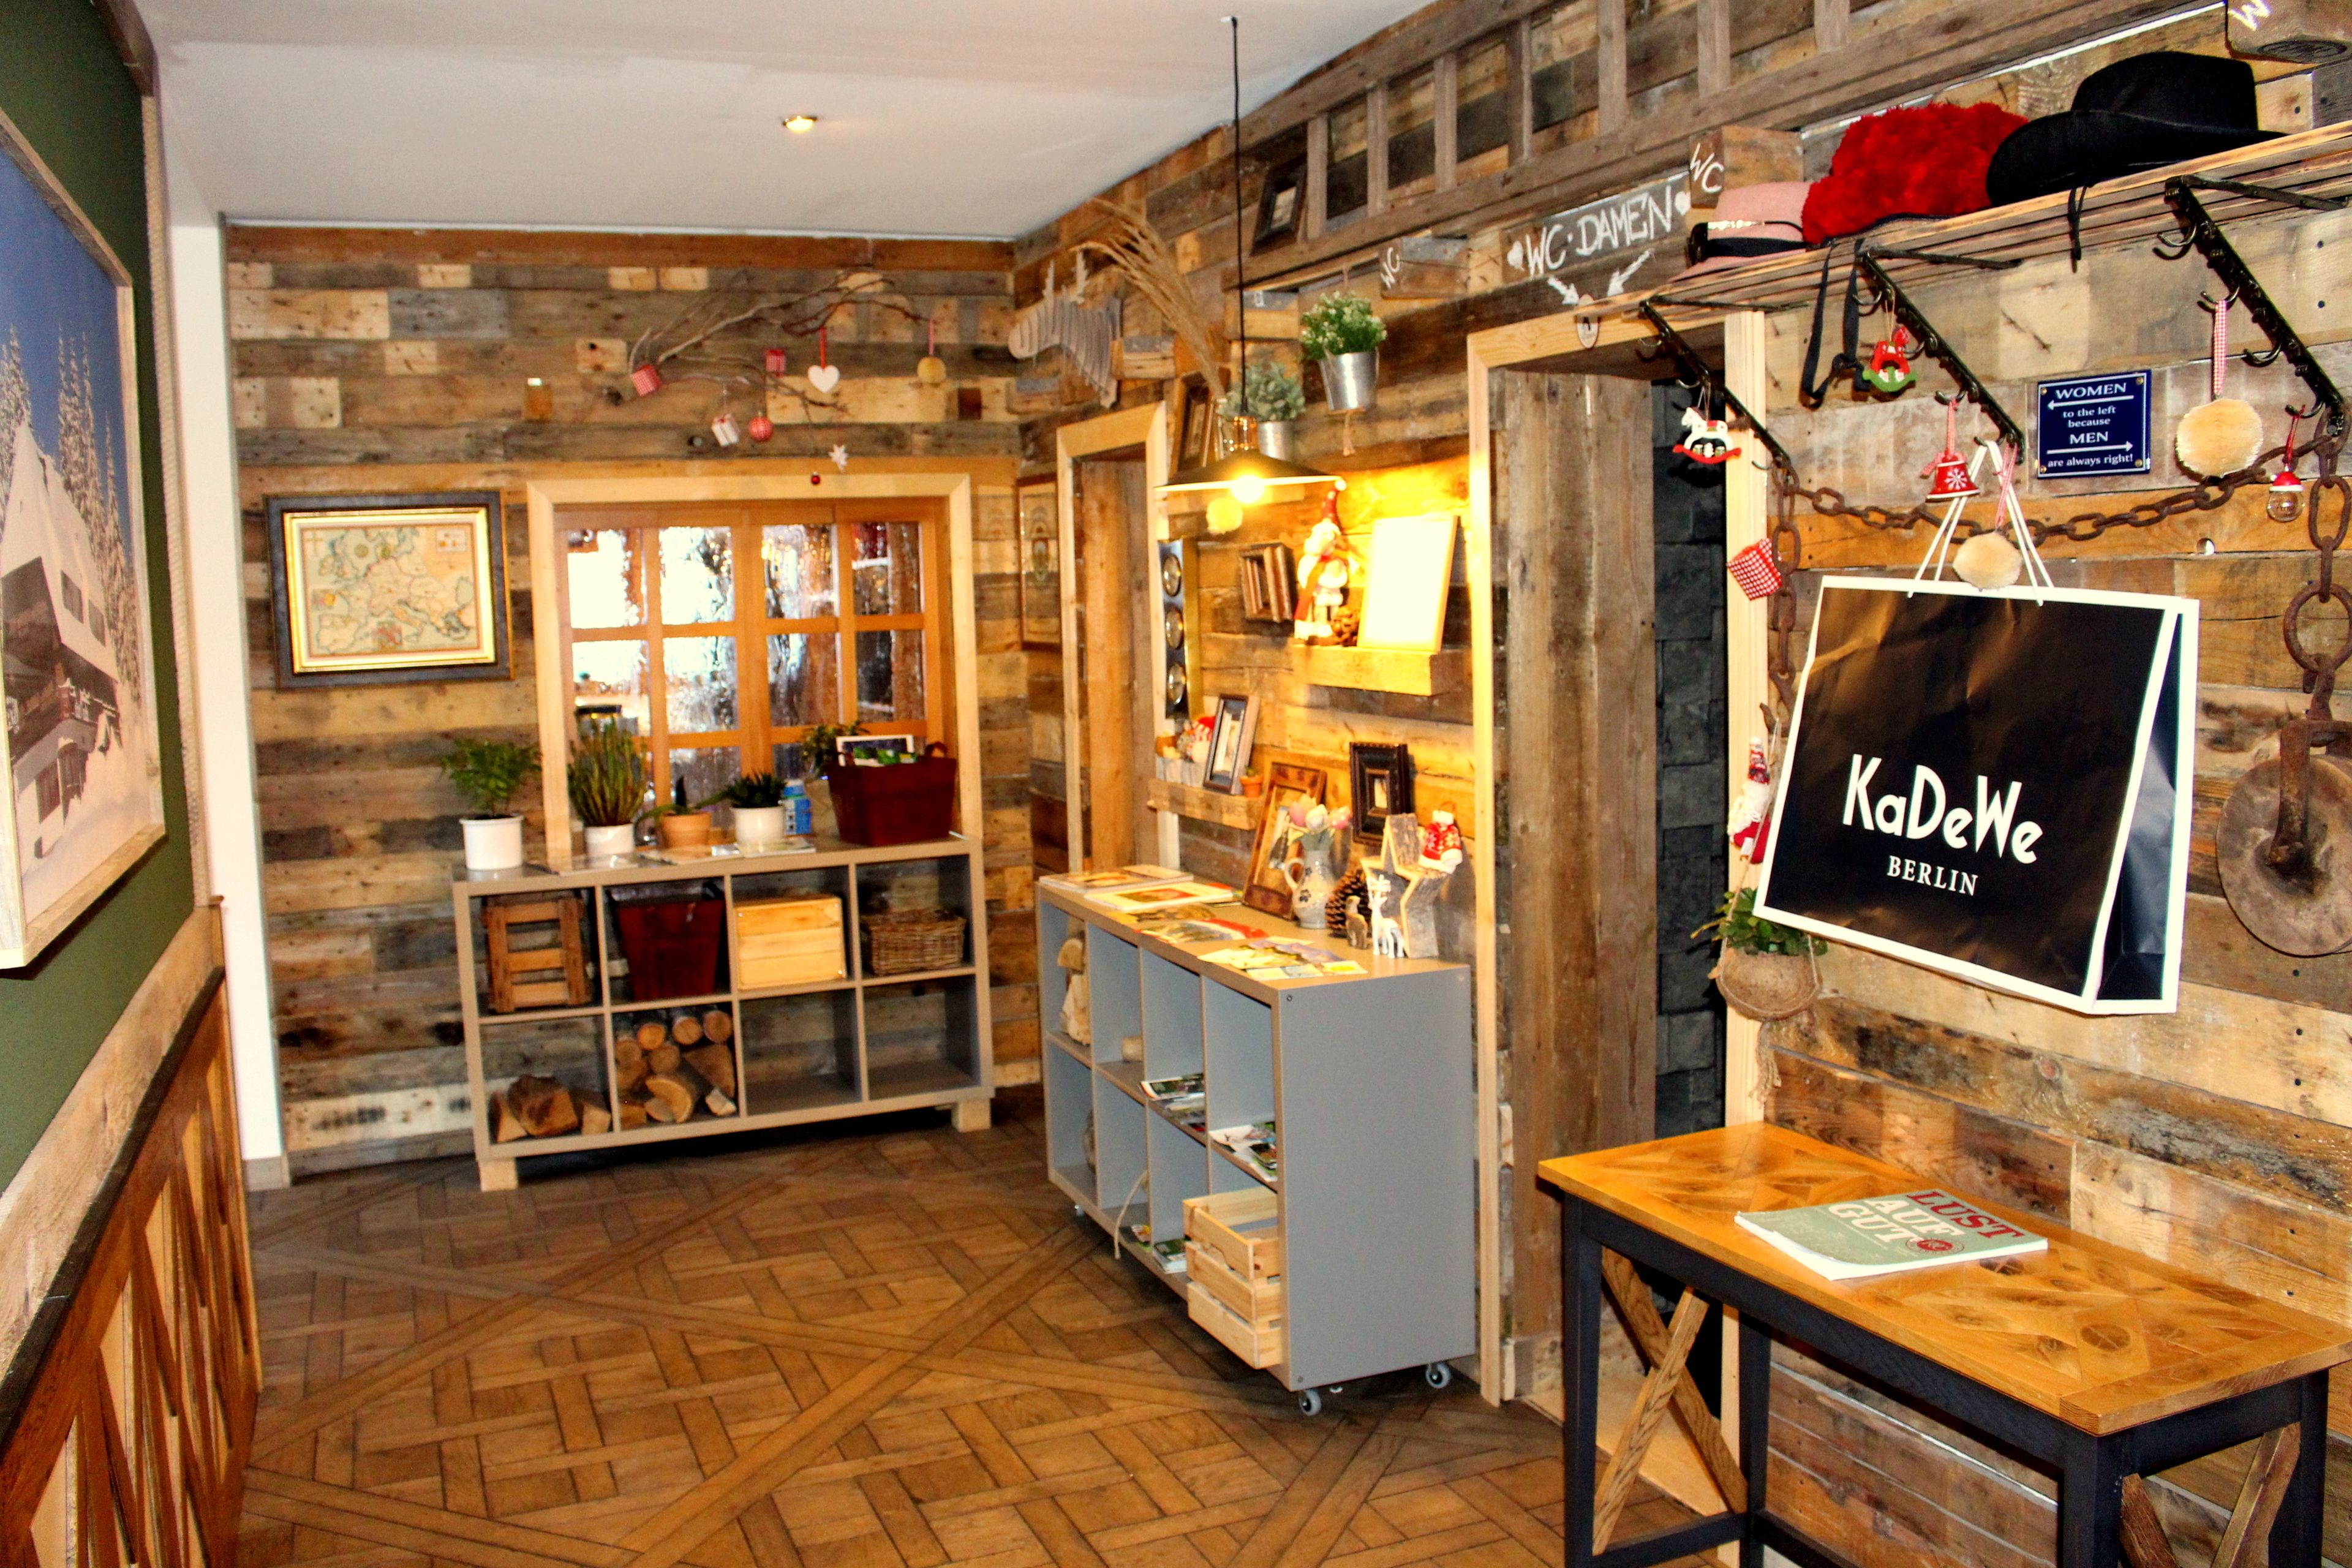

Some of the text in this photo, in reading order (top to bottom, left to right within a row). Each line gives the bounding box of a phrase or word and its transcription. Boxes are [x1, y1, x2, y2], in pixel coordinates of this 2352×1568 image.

[1689, 143, 1724, 194] WC
[1576, 185, 1673, 257] DAMEN
[1380, 247, 1401, 289] WC
[2055, 382, 2127, 399] WOMEN
[2068, 417, 2111, 428] because
[2078, 408, 2095, 417] the
[2098, 405, 2116, 415] left
[2069, 431, 2109, 445] MEN
[2067, 456, 2101, 467] always
[2103, 454, 2133, 467] right!
[1842, 753, 2043, 864] KaDeWe
[1887, 855, 1979, 896] BERLIN
[1828, 1204, 1924, 1243] GUT
[1864, 1199, 1966, 1237] AUF
[1906, 1191, 2024, 1239] LUST
